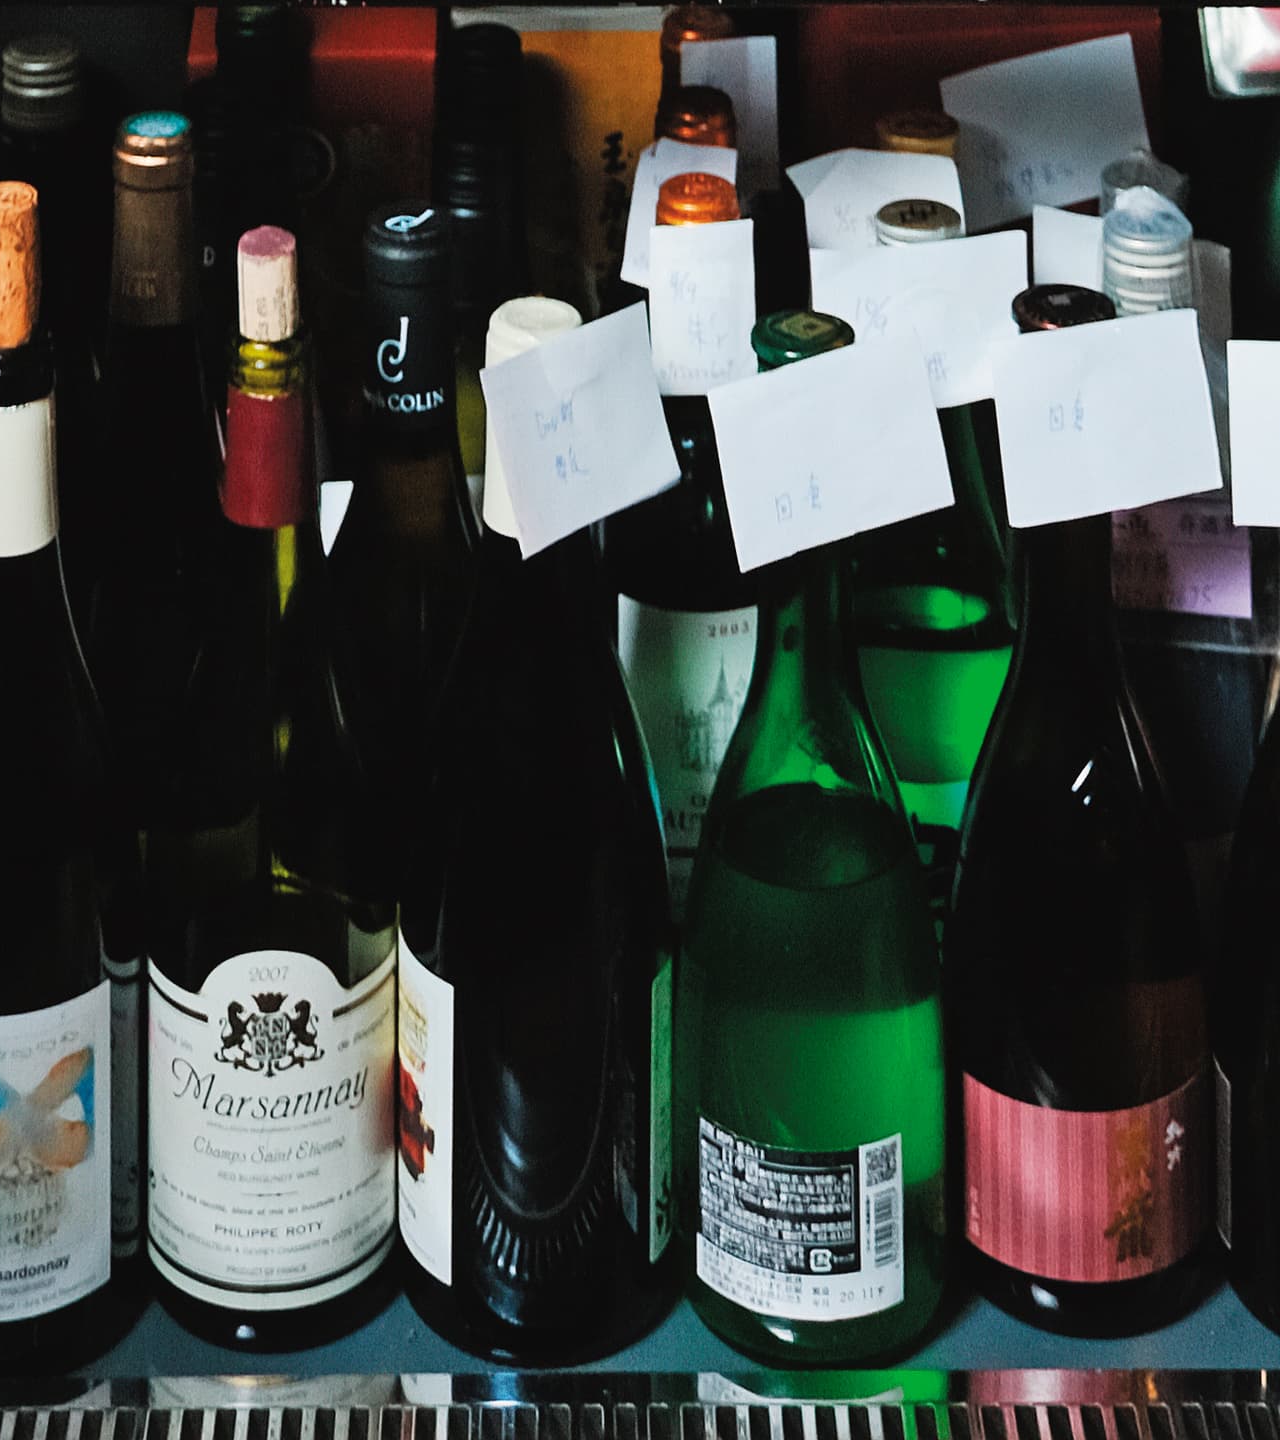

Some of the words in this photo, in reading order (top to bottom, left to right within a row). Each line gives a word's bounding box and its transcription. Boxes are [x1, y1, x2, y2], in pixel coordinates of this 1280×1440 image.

[387, 386, 445, 415] COLIN
[248, 965, 290, 983] 2007
[171, 1058, 369, 1121] Marsannay
[214, 1223, 279, 1238] PHILIPPE
[285, 1221, 324, 1236] ROTY
